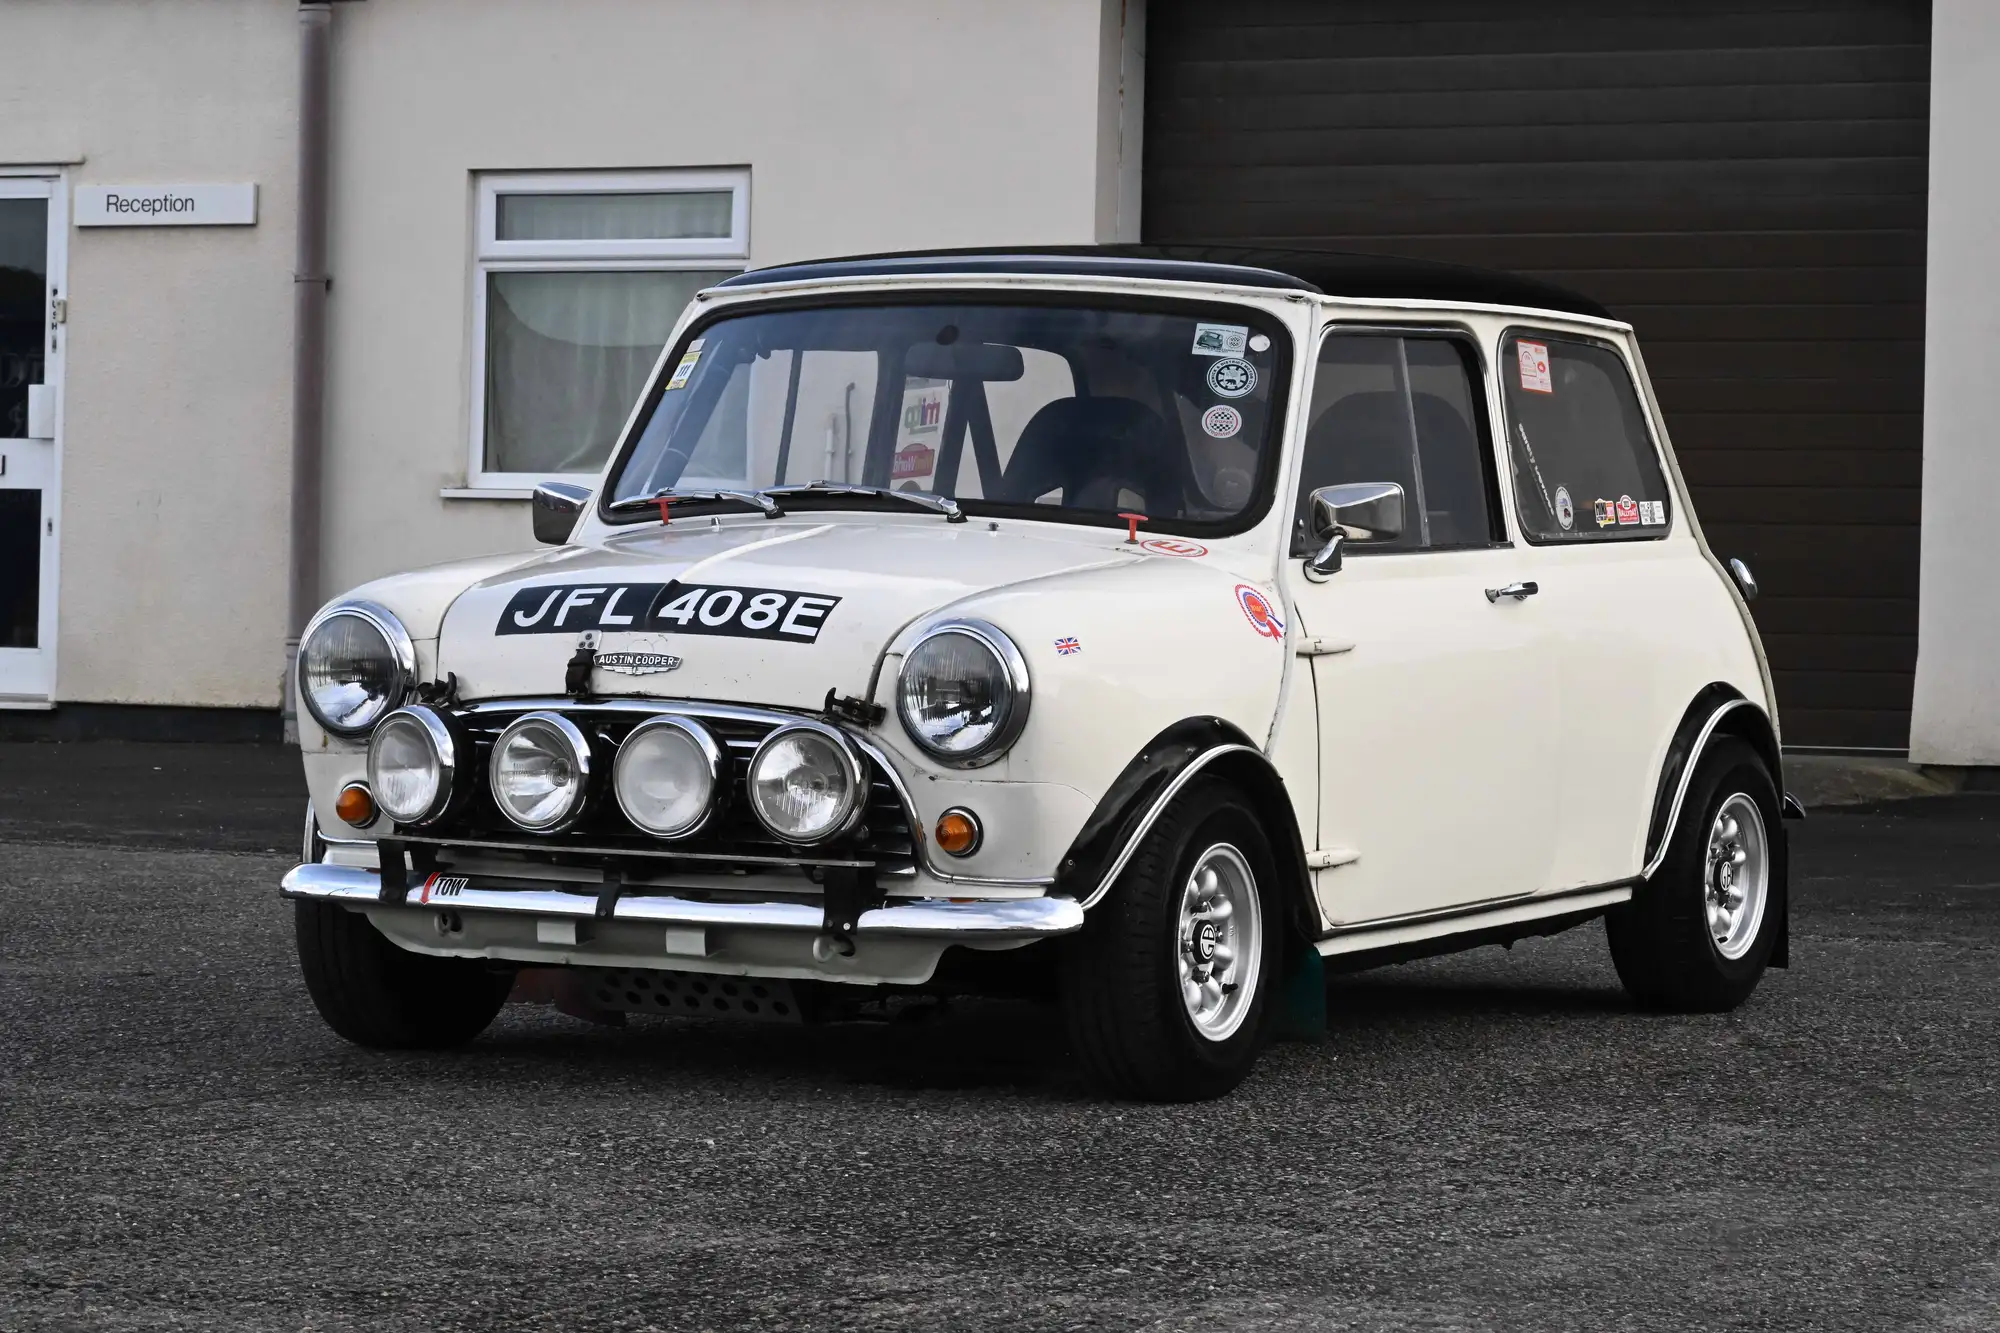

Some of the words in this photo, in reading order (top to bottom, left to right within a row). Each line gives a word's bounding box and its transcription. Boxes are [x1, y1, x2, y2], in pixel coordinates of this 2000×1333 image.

[106, 194, 195, 216] Reception
[513, 587, 634, 628] JFL
[657, 588, 836, 637] 408E
[598, 655, 633, 664] AUSTIN
[635, 656, 675, 666] COOPER
[435, 878, 467, 896] TOW
